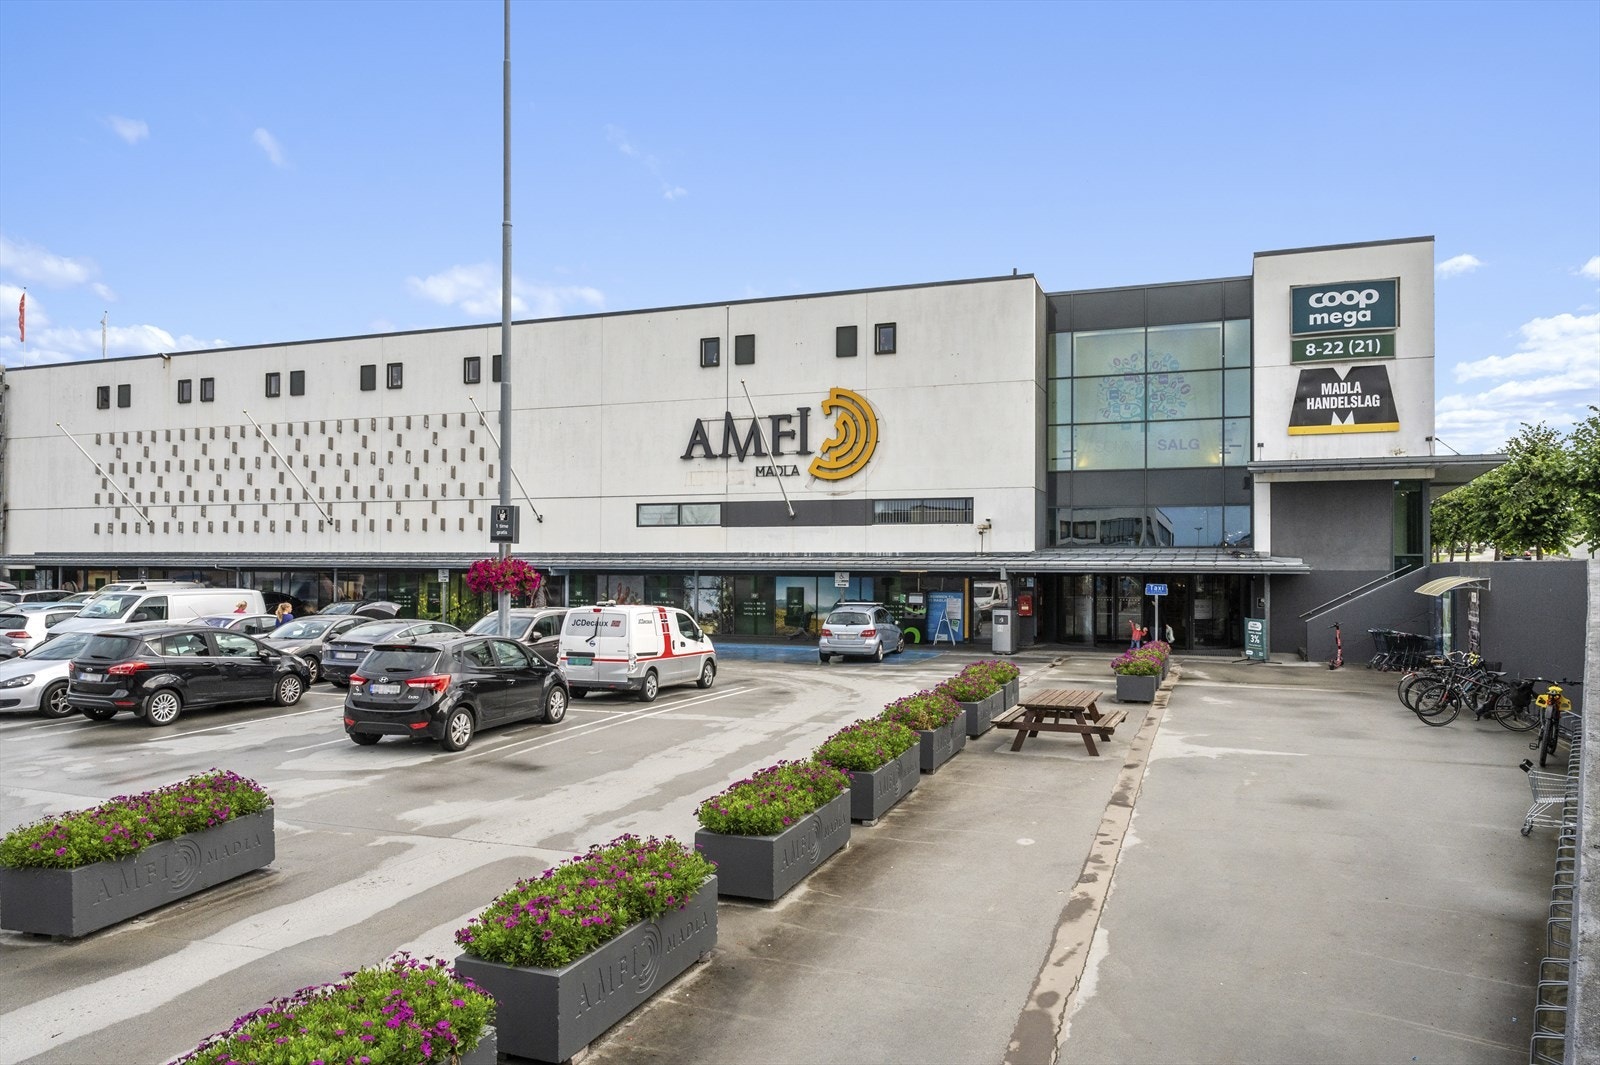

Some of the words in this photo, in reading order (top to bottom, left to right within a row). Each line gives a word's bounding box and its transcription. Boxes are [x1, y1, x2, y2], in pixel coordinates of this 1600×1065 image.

[1308, 289, 1380, 308] coop
[1308, 309, 1372, 327] mega
[1305, 341, 1344, 356] 8-22
[1348, 338, 1381, 355] (21)
[1321, 381, 1362, 396] MADLA
[1306, 394, 1381, 410] HANDELSLAG
[680, 407, 812, 462] AMFI
[1157, 438, 1200, 451] SALG
[755, 465, 800, 478] MADLA
[571, 618, 609, 627] JCDecaux
[1250, 634, 1260, 644] 3%
[92, 854, 169, 906] AMFI
[206, 833, 262, 865] MADLA
[575, 944, 639, 1019] AMFI
[666, 911, 709, 955] MADLA
